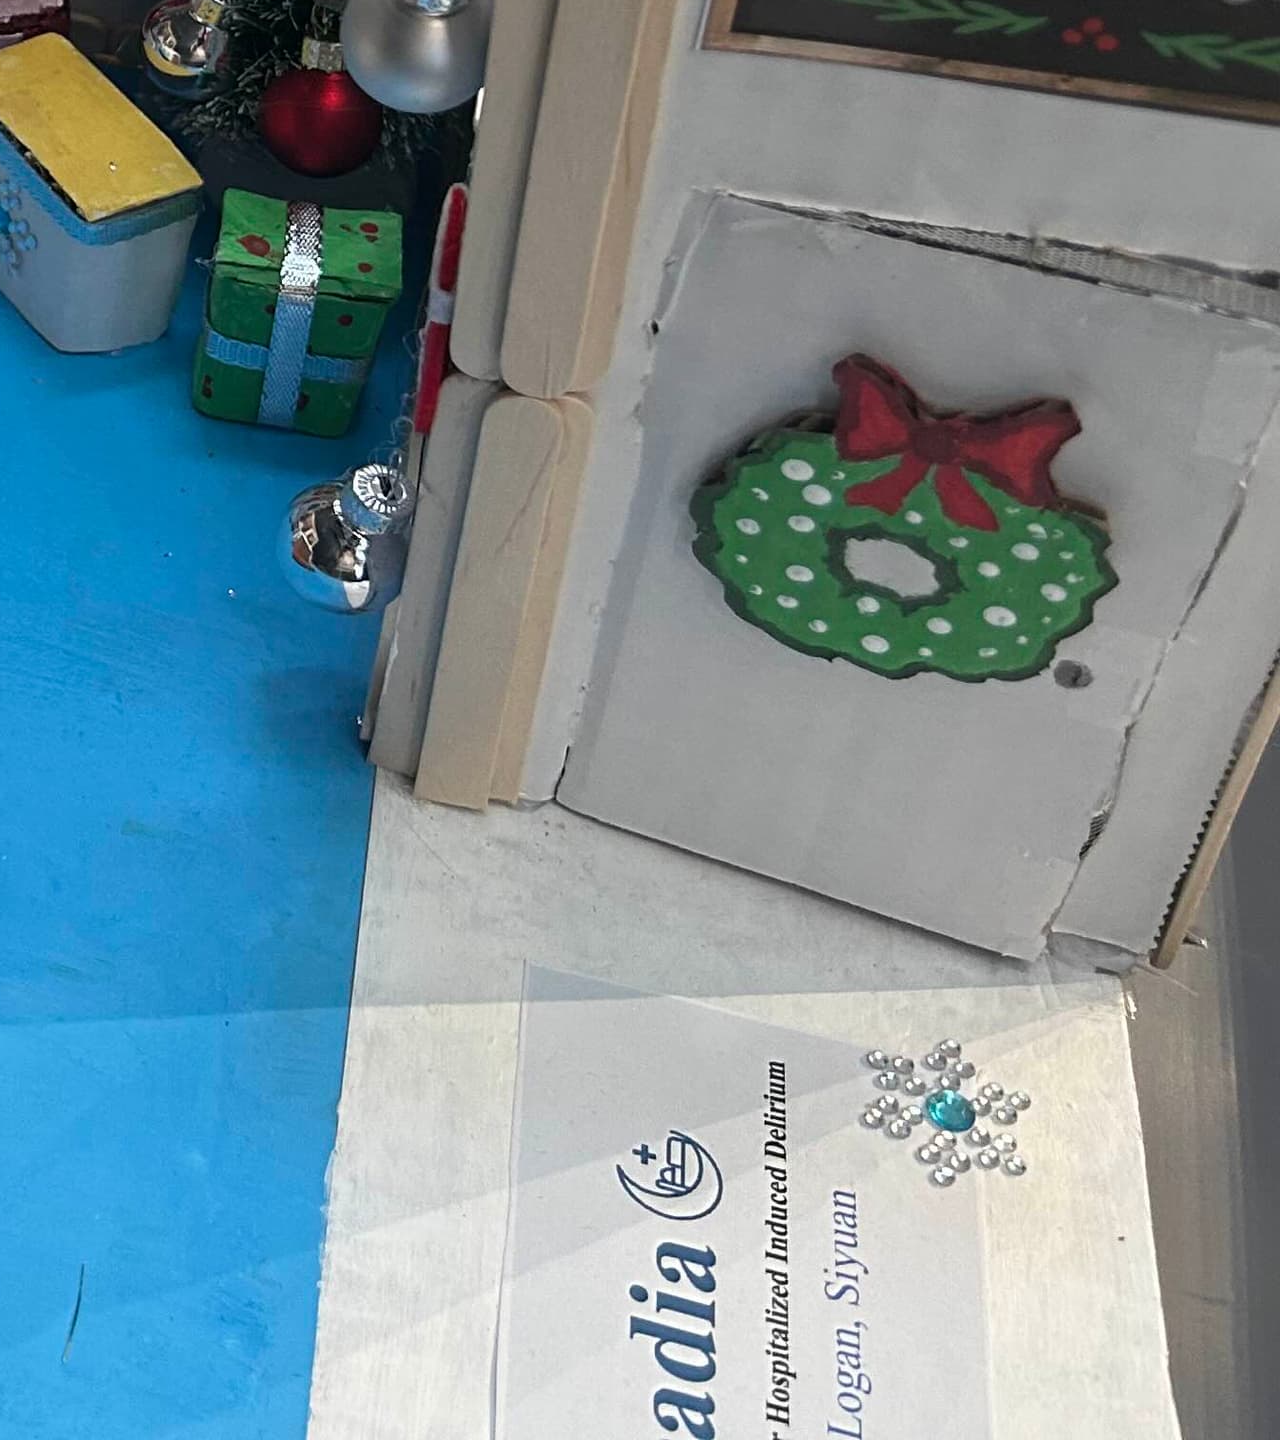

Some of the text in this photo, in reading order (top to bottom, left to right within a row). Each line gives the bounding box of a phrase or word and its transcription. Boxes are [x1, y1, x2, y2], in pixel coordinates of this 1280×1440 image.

[763, 1061, 788, 1162] Delirium
[764, 1165, 789, 1264] Induced
[629, 1241, 717, 1440] adia
[765, 1268, 797, 1427] Hospitalized
[823, 1189, 872, 1440] Logan, Siyuan
